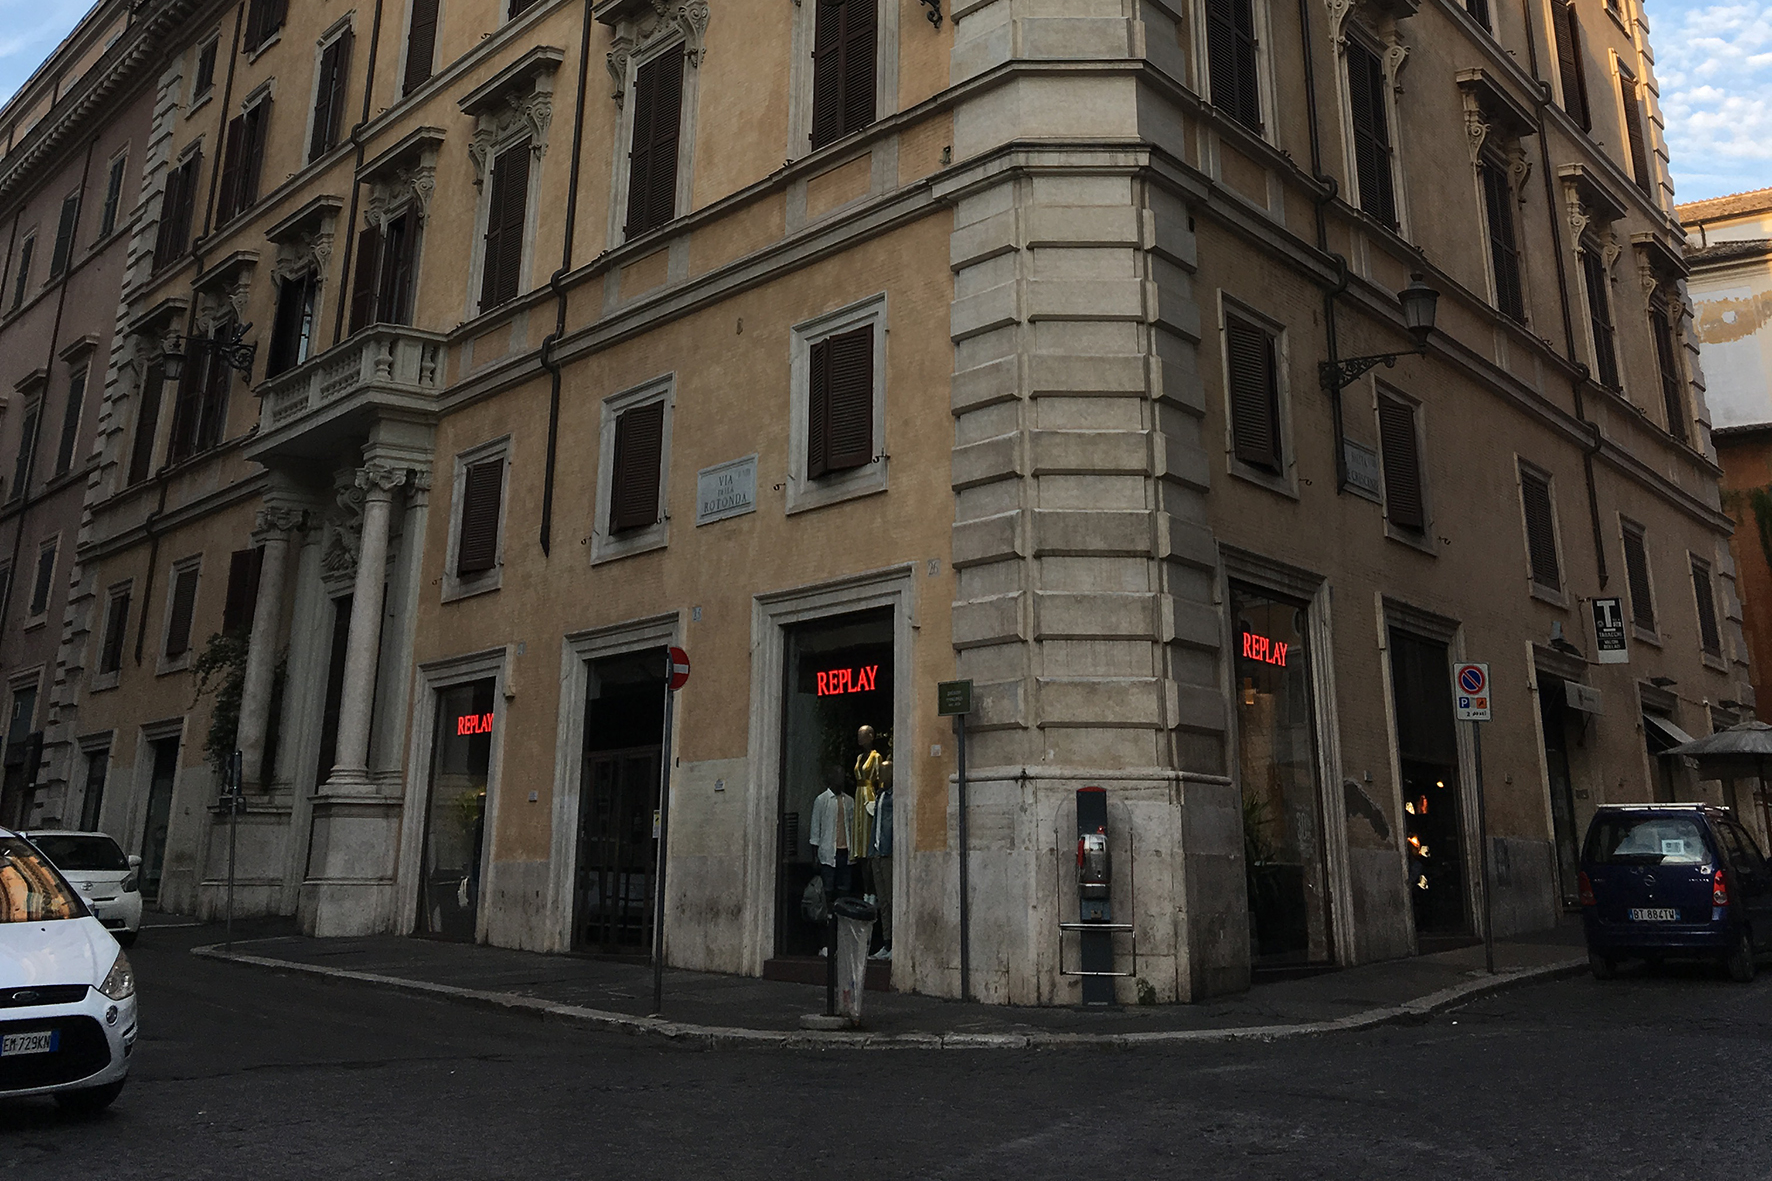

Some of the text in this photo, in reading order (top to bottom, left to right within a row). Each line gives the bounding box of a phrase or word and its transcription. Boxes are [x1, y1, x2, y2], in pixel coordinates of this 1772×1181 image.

[718, 474, 733, 486] VIA
[704, 493, 747, 513] ROTONDA
[1242, 631, 1288, 667] REPLAY
[816, 664, 879, 697] REPLAY
[1461, 698, 1469, 708] P
[457, 712, 494, 736] REPLAY
[18, 1035, 51, 1051] 729KN
